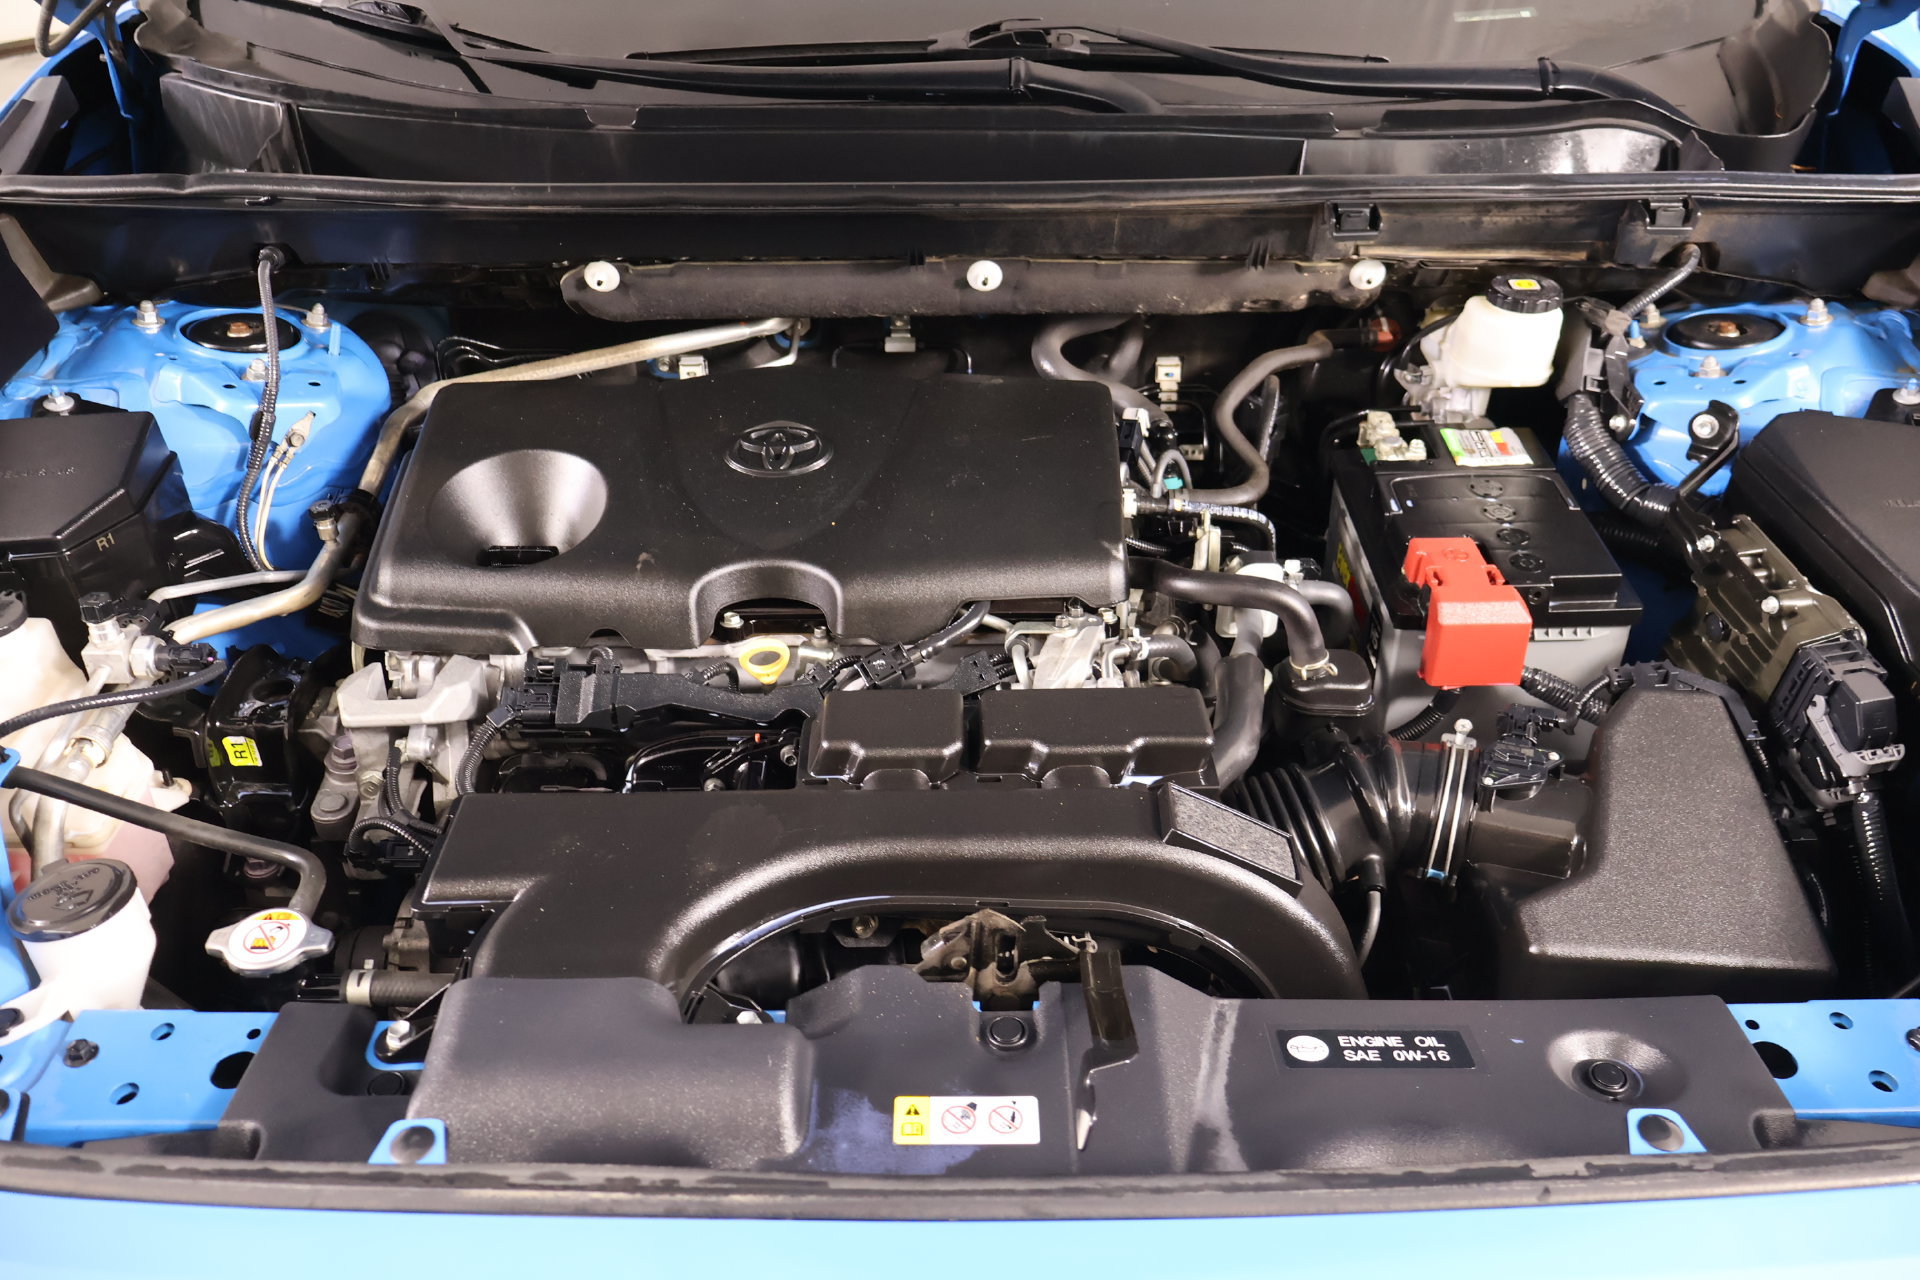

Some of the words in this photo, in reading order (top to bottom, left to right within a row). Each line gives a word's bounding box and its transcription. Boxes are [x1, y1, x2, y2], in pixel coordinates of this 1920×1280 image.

[95, 532, 115, 551] R1
[230, 743, 249, 759] R1
[1337, 1035, 1405, 1048] ENGINE
[1414, 1036, 1446, 1048] OIL
[1343, 1049, 1382, 1062] SAE
[1393, 1049, 1451, 1062] 0W-16
